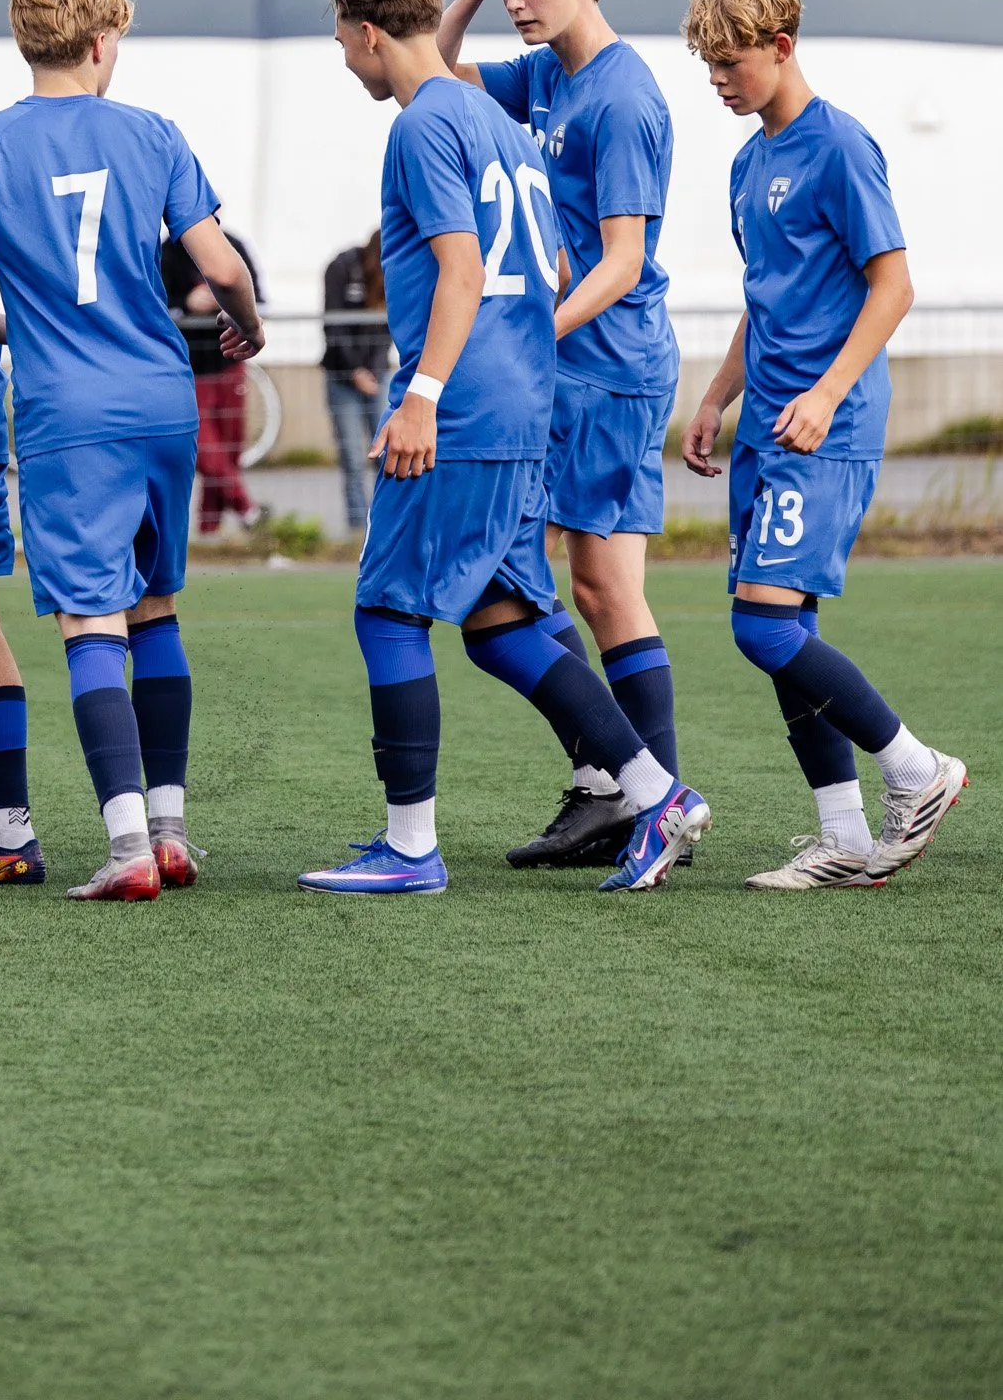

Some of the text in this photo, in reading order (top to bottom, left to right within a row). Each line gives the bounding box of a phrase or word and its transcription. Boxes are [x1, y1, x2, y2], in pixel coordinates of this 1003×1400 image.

[51, 168, 109, 306] 7
[480, 160, 560, 297] 20
[758, 488, 804, 547] 13
